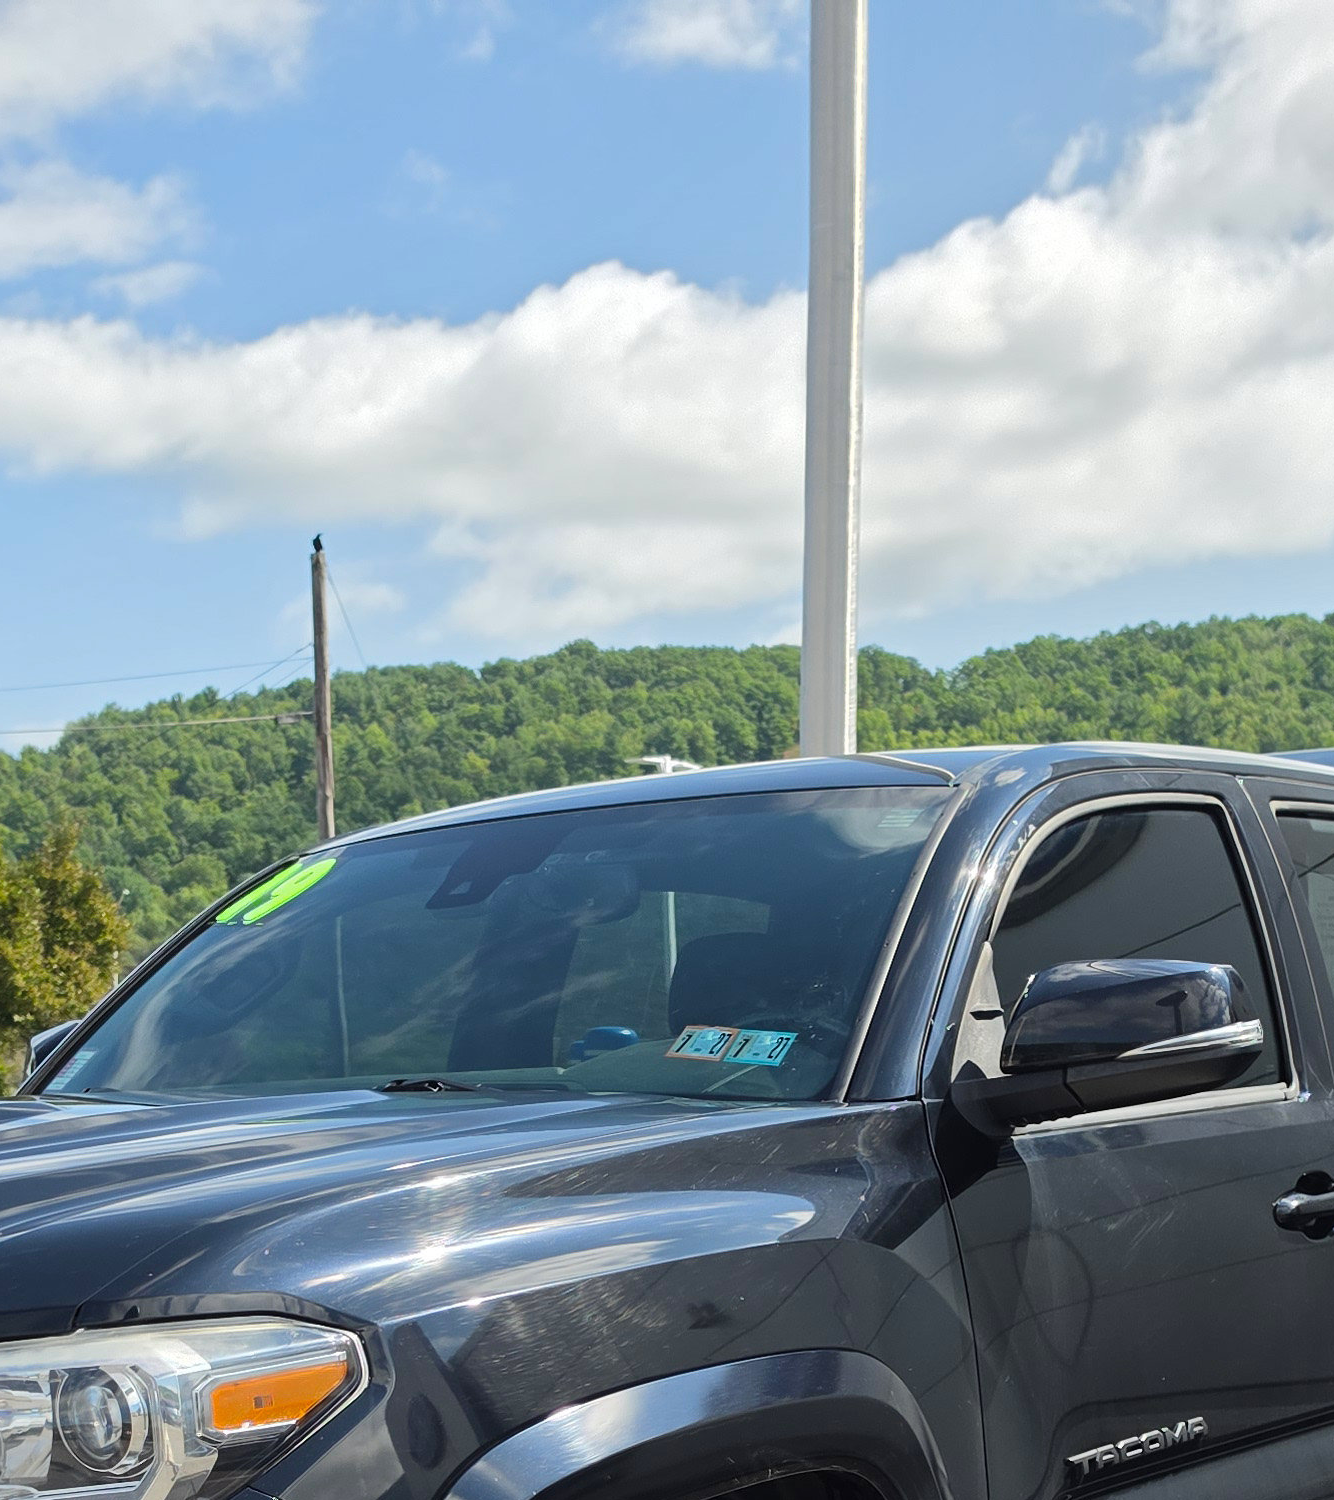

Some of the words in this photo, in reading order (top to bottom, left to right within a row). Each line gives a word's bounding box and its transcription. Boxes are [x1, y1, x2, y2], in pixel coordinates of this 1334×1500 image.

[215, 858, 337, 925] 19
[675, 1033, 693, 1053] 7
[708, 1032, 733, 1057] 27
[732, 1038, 750, 1058] 7
[767, 1036, 791, 1061] 27
[1067, 1416, 1209, 1475] TACOMA
